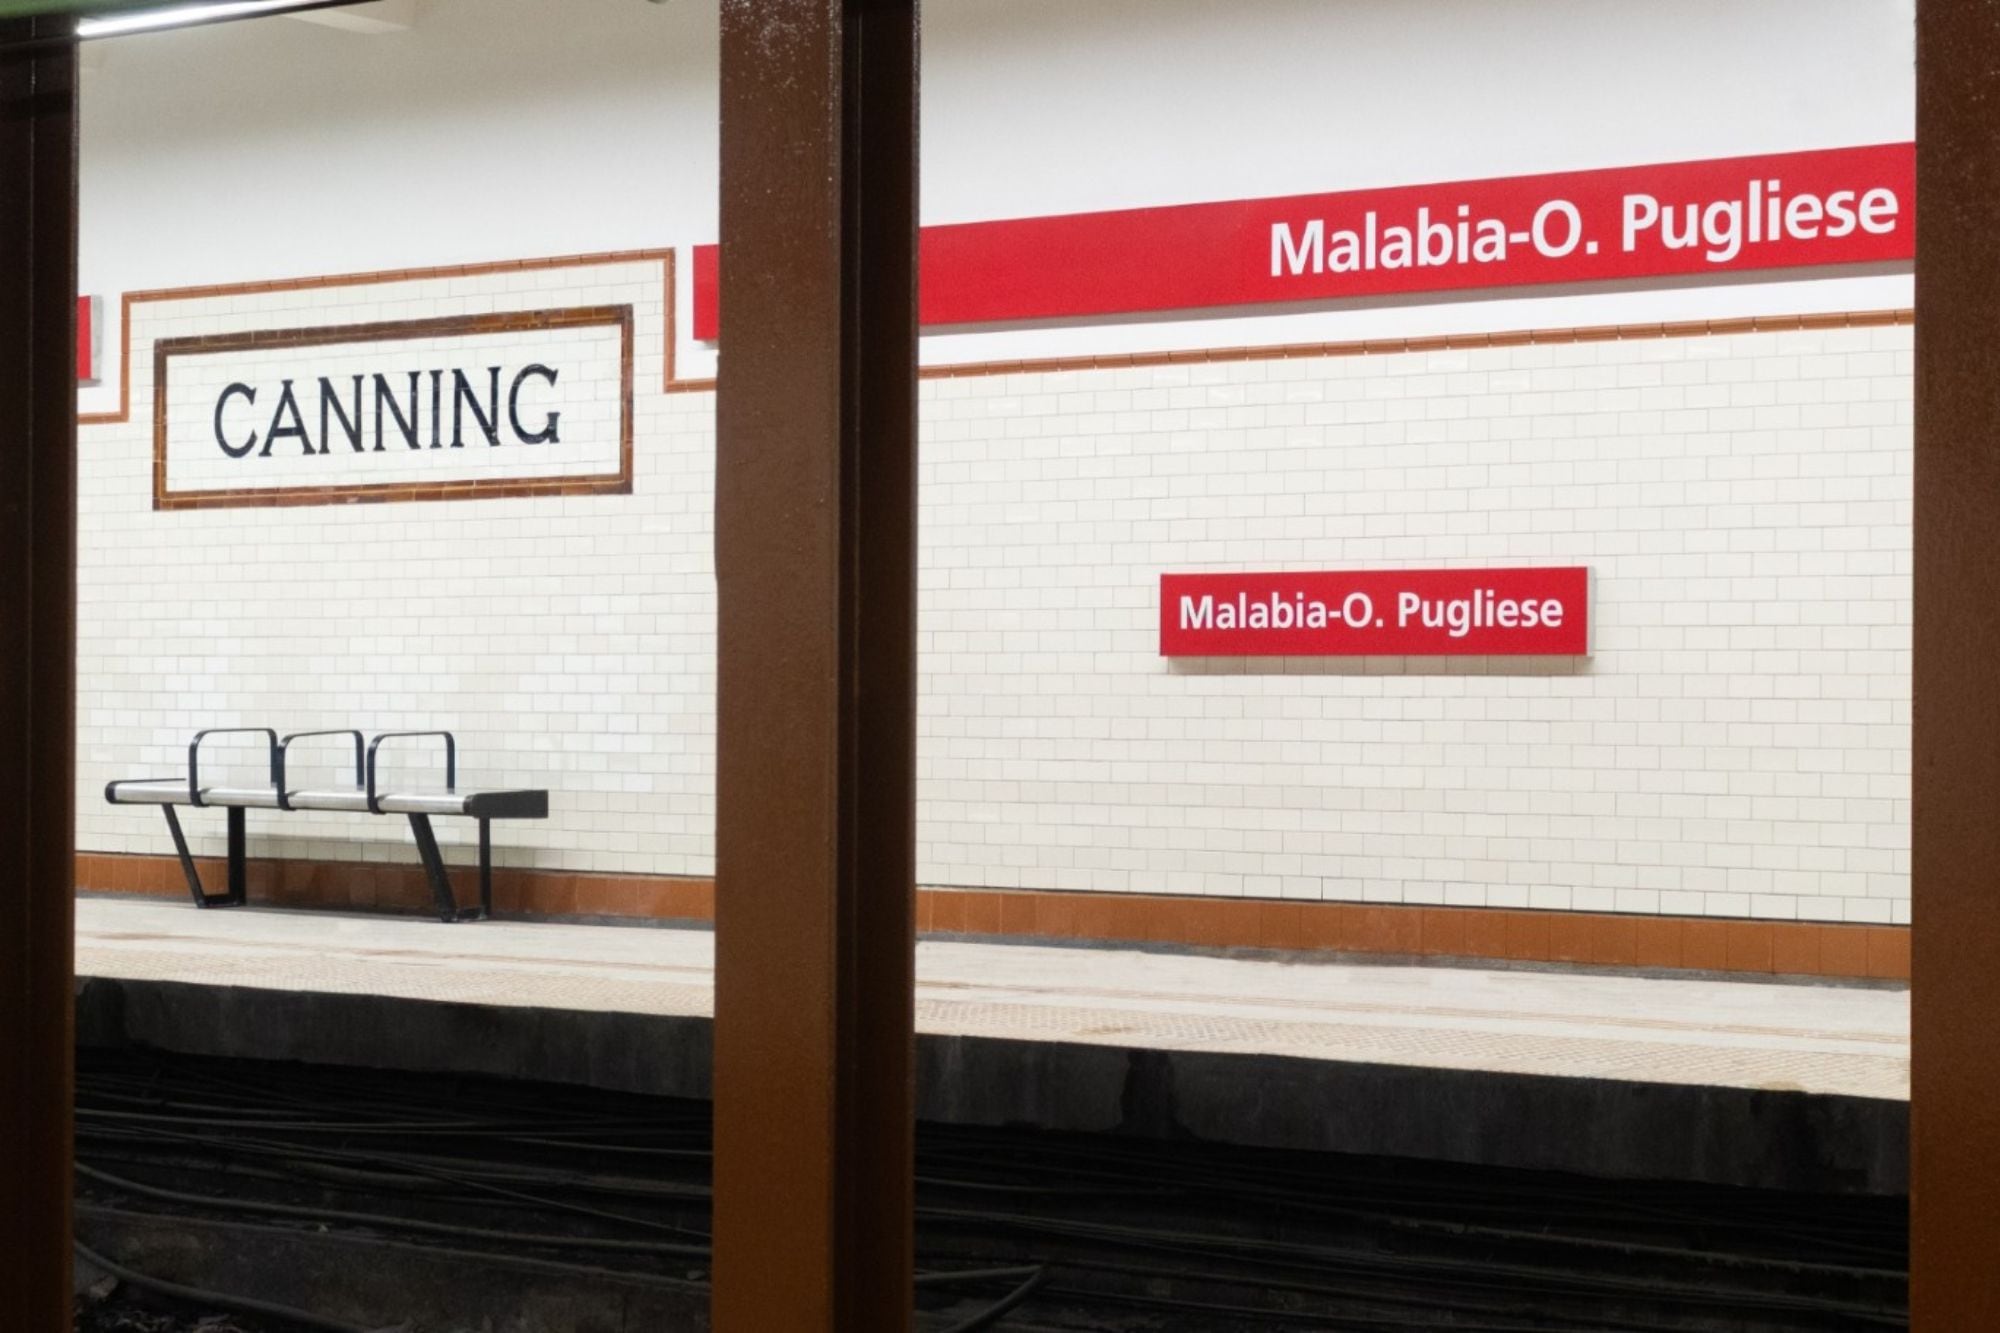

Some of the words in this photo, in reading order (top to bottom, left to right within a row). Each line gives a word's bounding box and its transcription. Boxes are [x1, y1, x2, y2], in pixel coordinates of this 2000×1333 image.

[1270, 199, 1599, 277] Malabia-O.
[1622, 179, 1899, 263] Pugliese
[214, 364, 559, 458] CANNING
[1180, 591, 1384, 630] Malabia-O.
[1398, 588, 1564, 638] Pugliese
